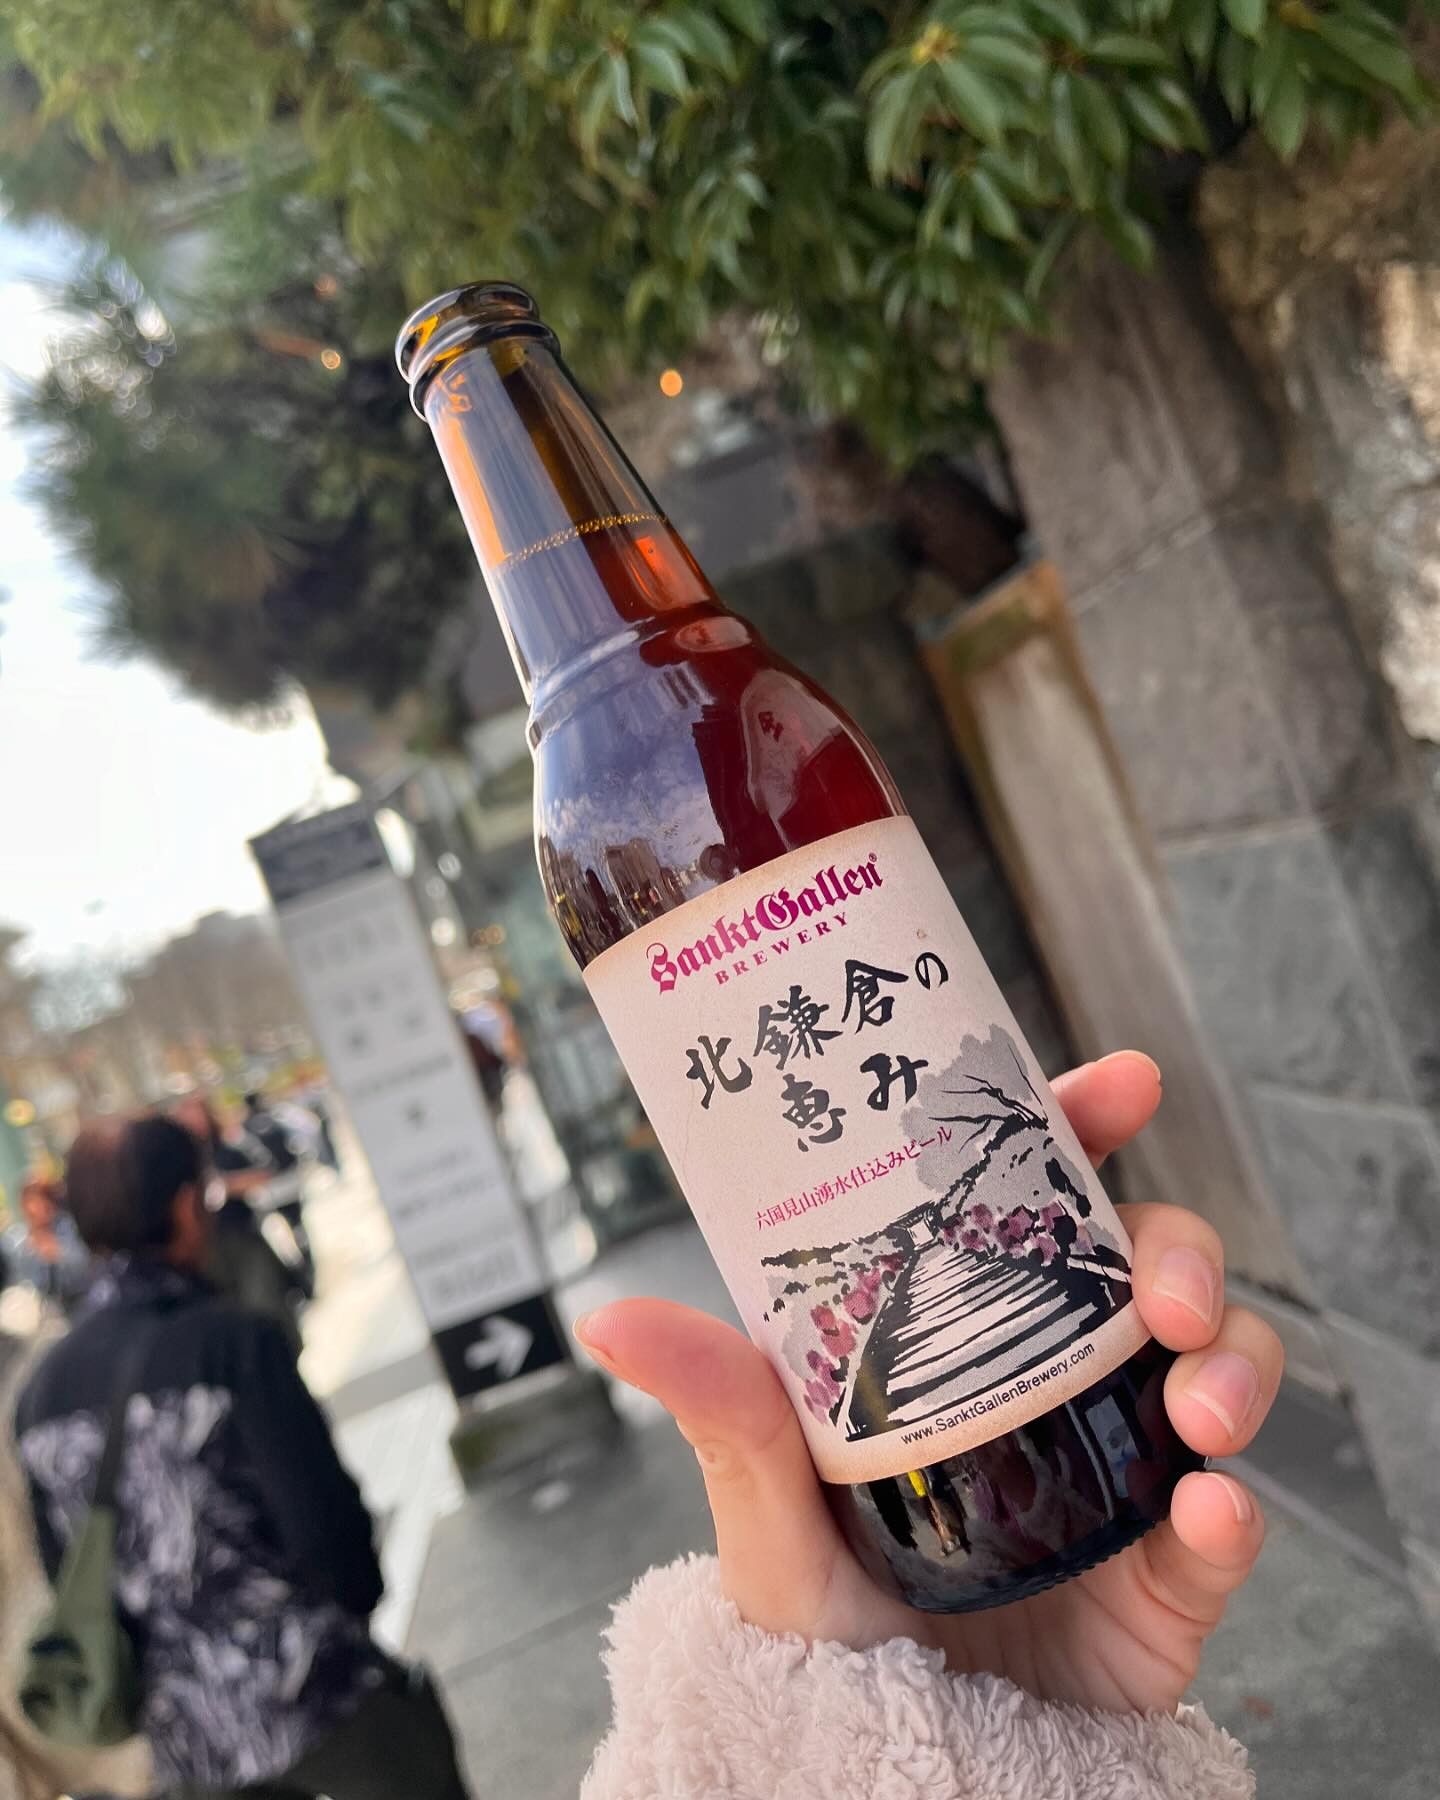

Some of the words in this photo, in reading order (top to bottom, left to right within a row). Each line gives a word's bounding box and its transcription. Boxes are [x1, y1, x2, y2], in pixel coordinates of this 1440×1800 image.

[715, 911, 847, 985] BREWERY
[685, 951, 949, 1110] 北鎌倉の
[781, 1053, 929, 1152] 恵み
[755, 1126, 952, 1231] 六国見山湧水仕込みビール
[901, 1342, 1095, 1445] www.SanktGallenBrewery.com
